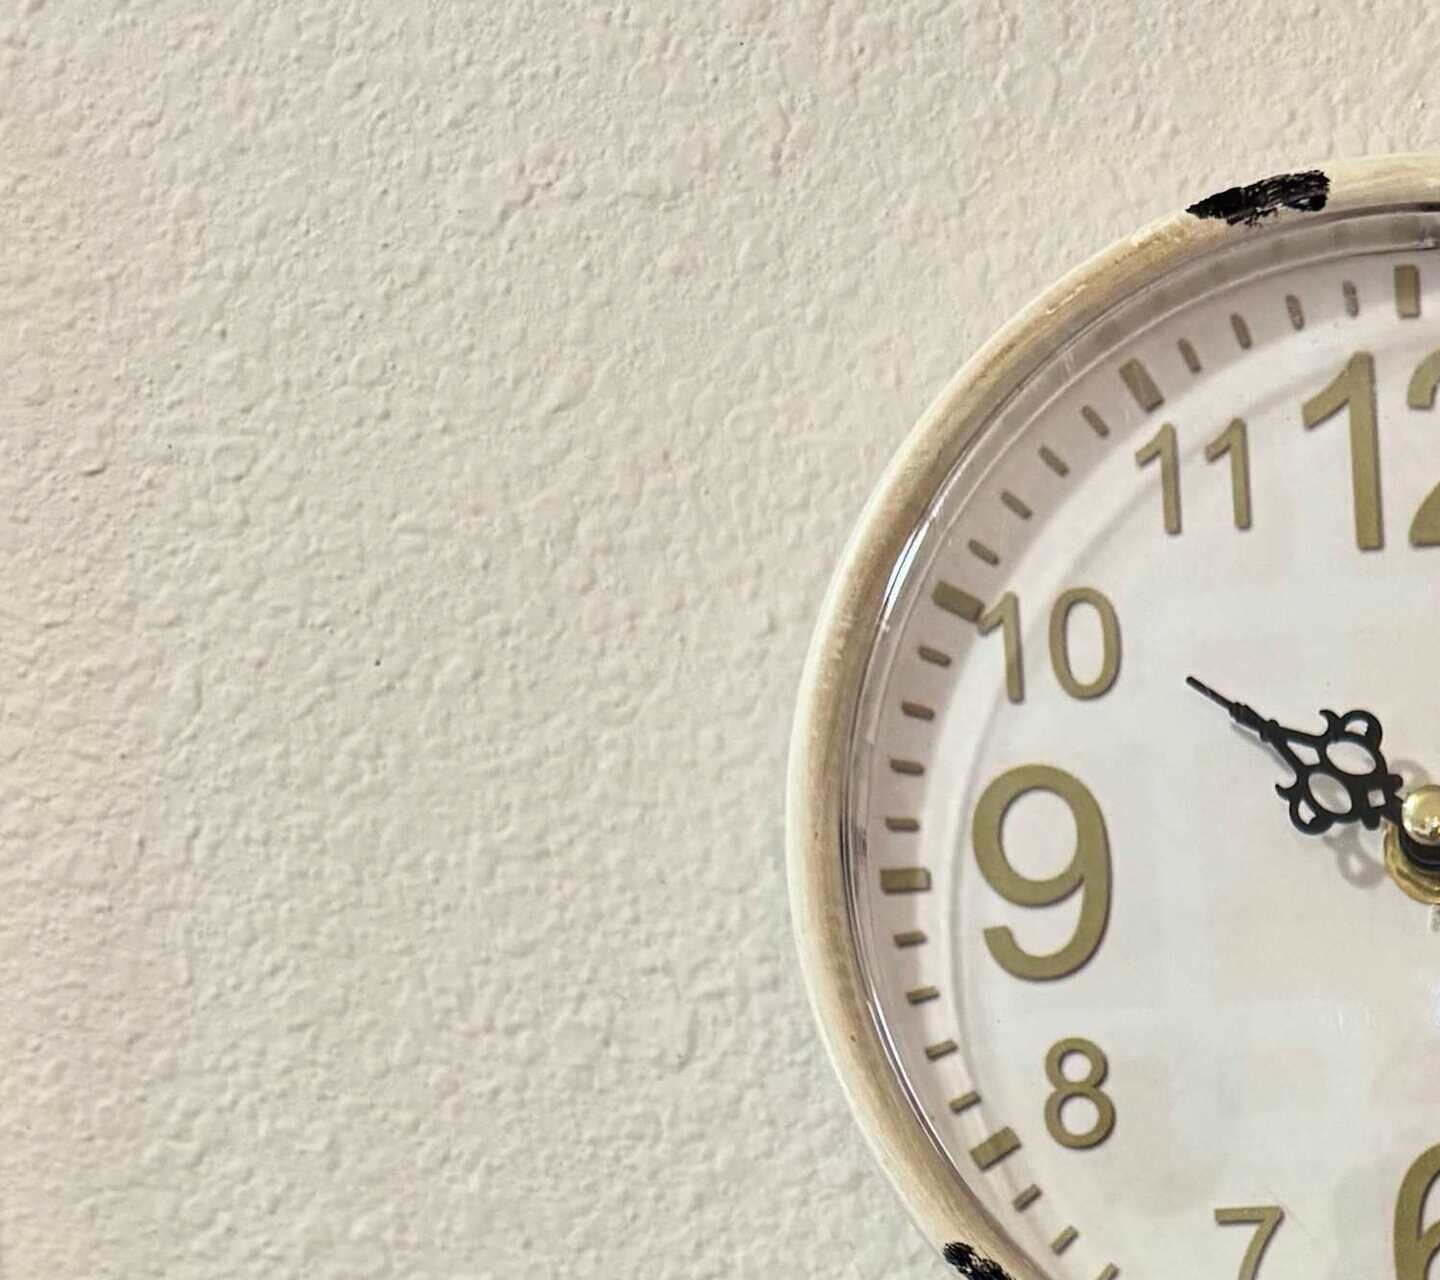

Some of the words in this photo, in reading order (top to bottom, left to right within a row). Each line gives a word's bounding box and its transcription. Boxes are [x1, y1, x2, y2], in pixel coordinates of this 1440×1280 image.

[1135, 418, 1251, 534] 11
[979, 586, 1120, 703] 10
[971, 765, 1113, 981] 9
[1043, 1038, 1116, 1149] 8
